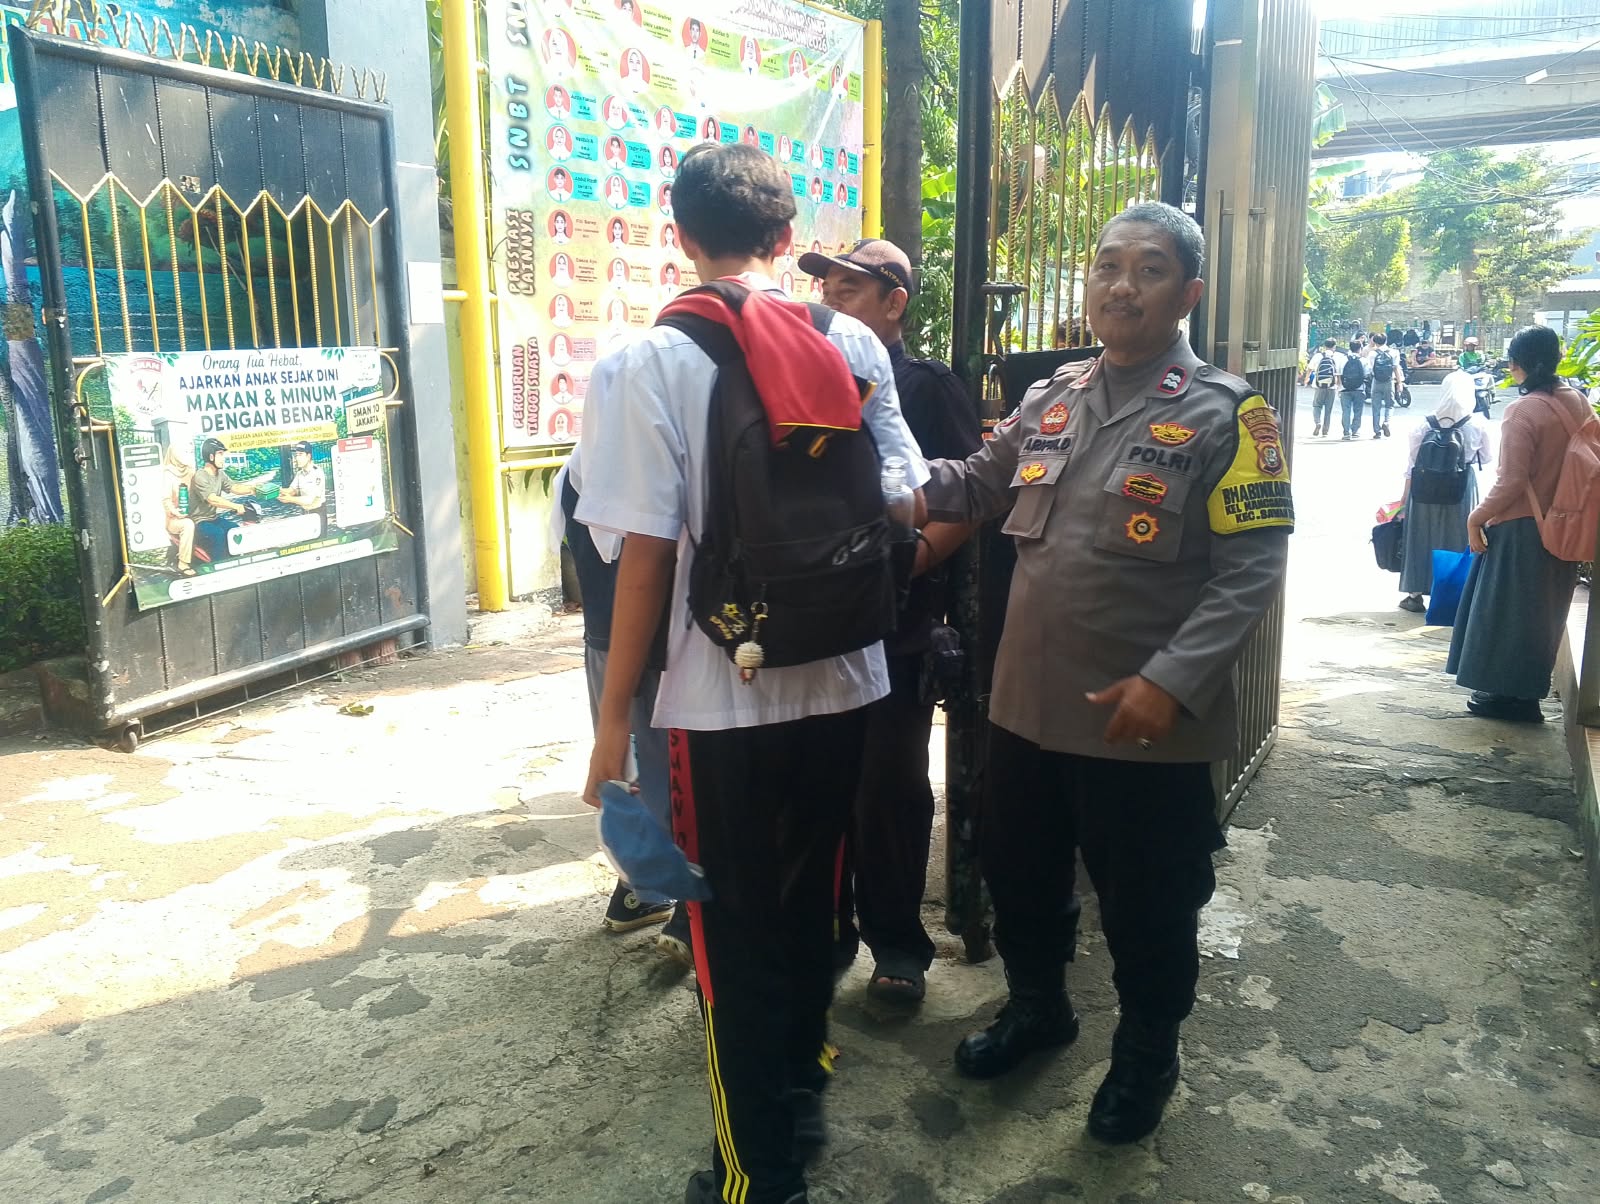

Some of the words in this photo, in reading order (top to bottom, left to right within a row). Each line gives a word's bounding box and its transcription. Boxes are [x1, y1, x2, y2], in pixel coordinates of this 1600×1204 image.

[507, 76, 529, 169] SNBT
[506, 209, 521, 294] PRESTASI
[520, 211, 535, 295] LAINNYA
[203, 354, 240, 373] Orang
[246, 353, 265, 368] Tua
[527, 337, 540, 387] SWASTA
[180, 373, 241, 390] AJARKAN
[245, 371, 278, 387] ANAK
[281, 368, 316, 385] SEJAK
[317, 368, 339, 382] DINI
[512, 344, 525, 428] PERGURUAN
[186, 390, 258, 413] MAKAN
[265, 388, 276, 407] &
[281, 385, 337, 405] MINUM
[353, 406, 371, 418] SMAN
[527, 389, 540, 436] TINGGI
[201, 408, 277, 433] DENGAN
[281, 404, 335, 425] BENAR
[355, 415, 380, 428] JAKARTA
[1128, 445, 1193, 472] POLRI
